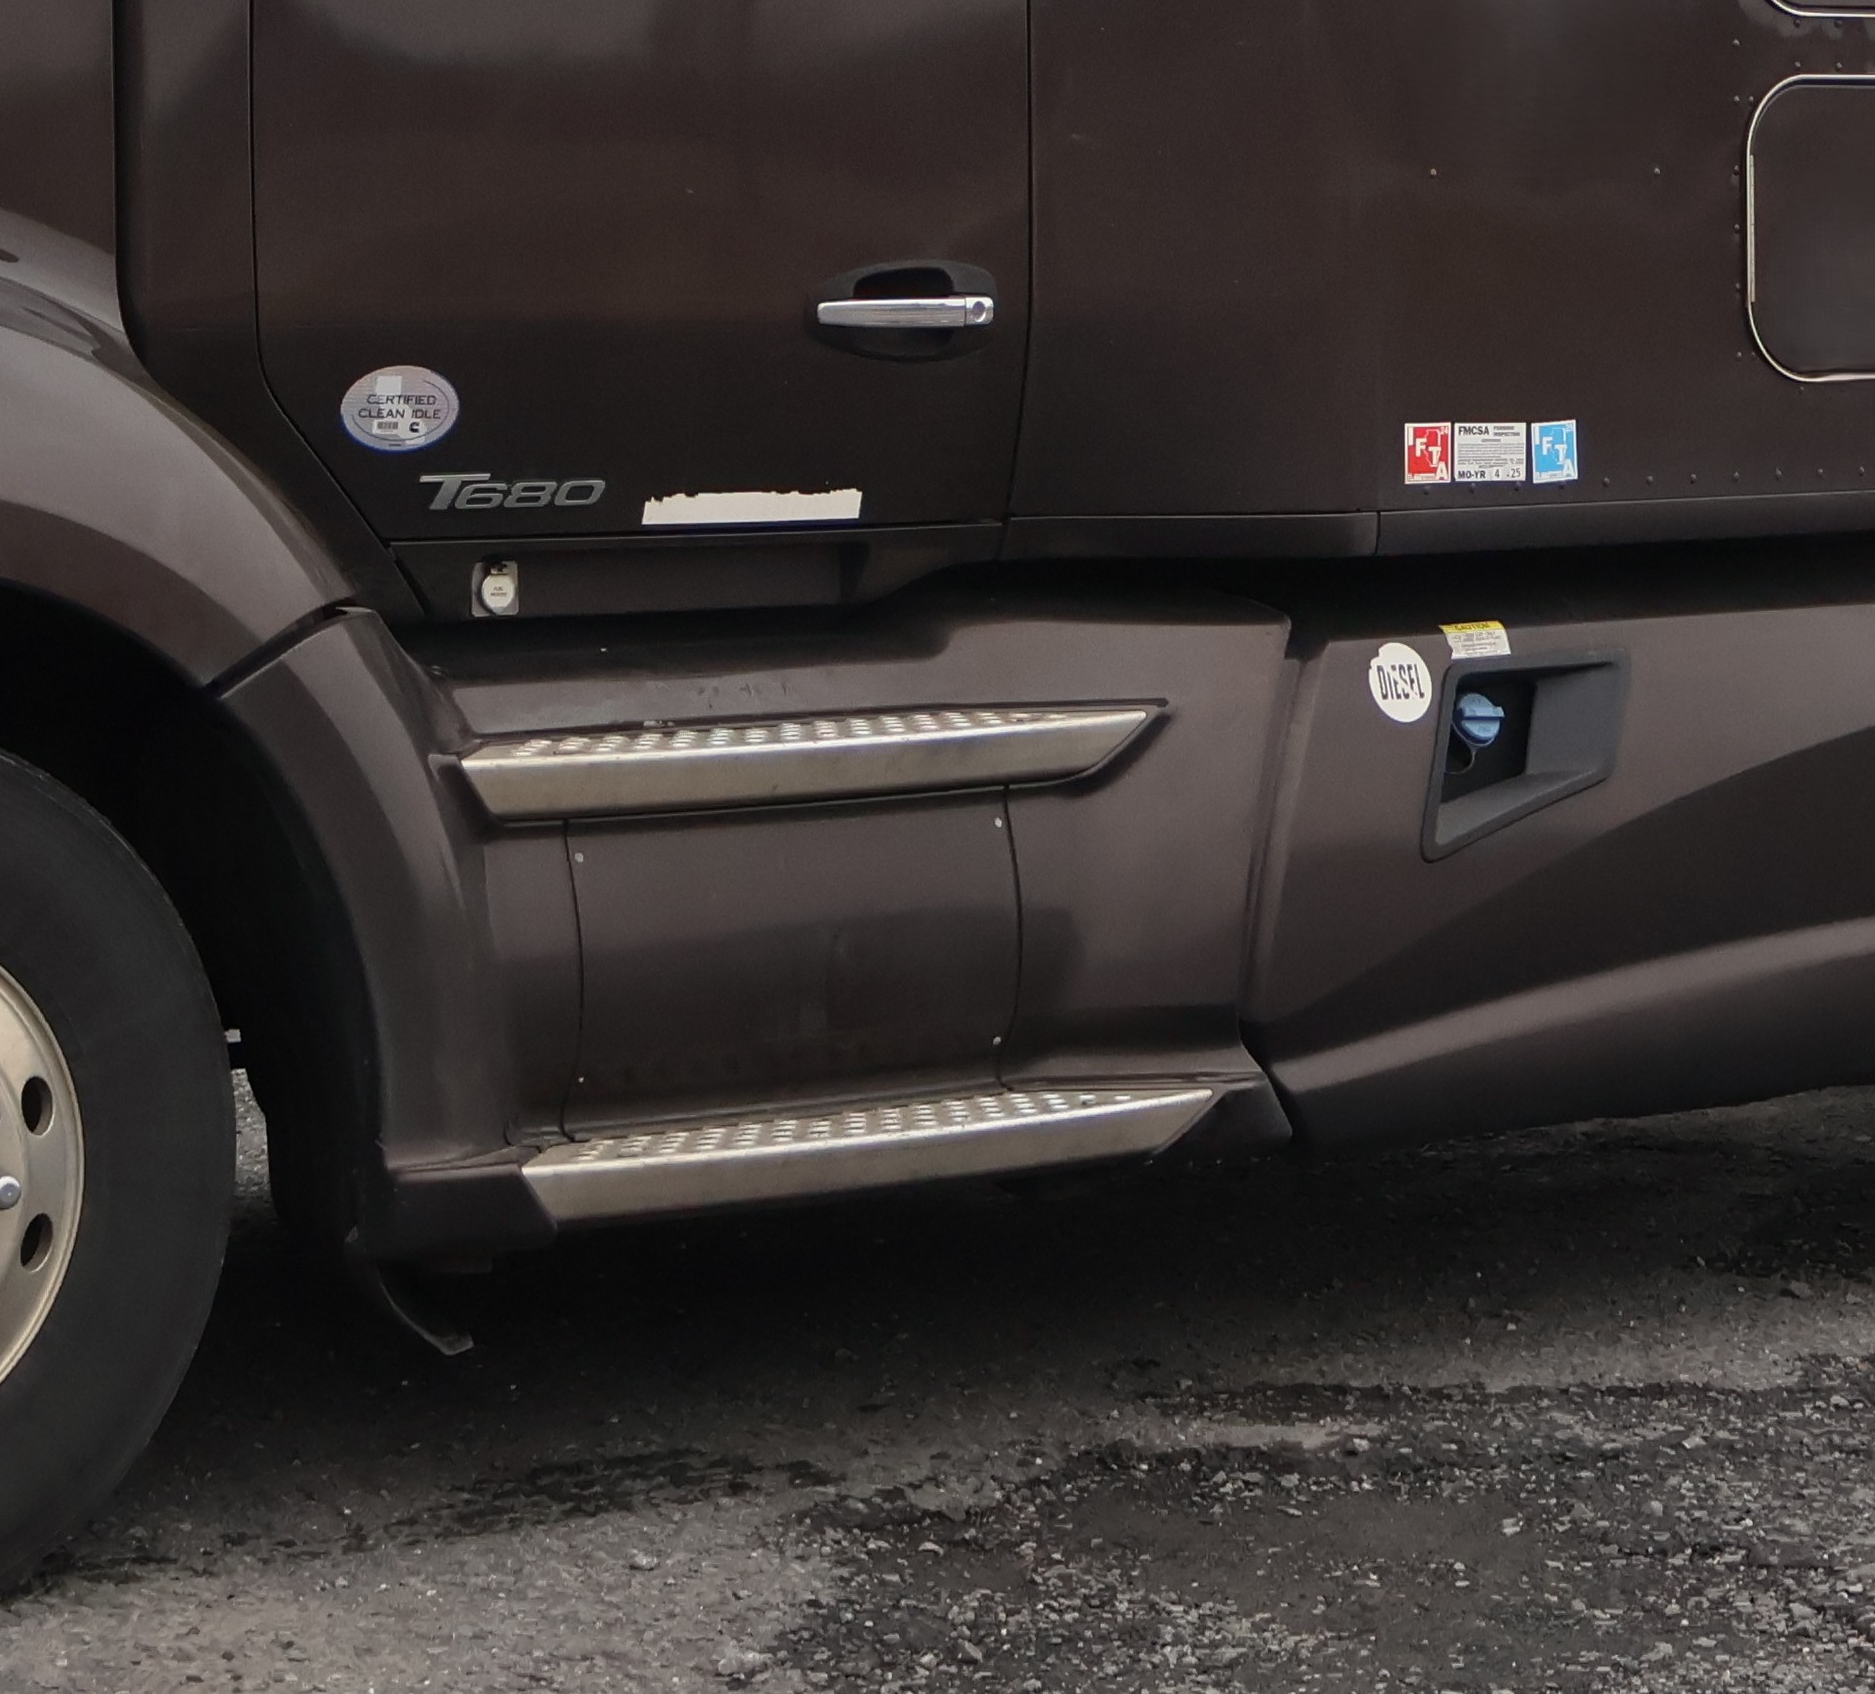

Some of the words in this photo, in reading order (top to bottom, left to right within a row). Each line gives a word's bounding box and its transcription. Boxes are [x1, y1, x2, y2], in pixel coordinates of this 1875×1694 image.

[366, 394, 437, 405] CERTIFIED
[358, 408, 405, 419] CLEAN
[411, 409, 441, 419] IDLE
[1458, 426, 1490, 436] FMCSA
[1457, 470, 1486, 479] MO-YR
[1494, 469, 1500, 478] 4
[419, 473, 606, 511] T680
[1376, 663, 1425, 700] DIESEL
